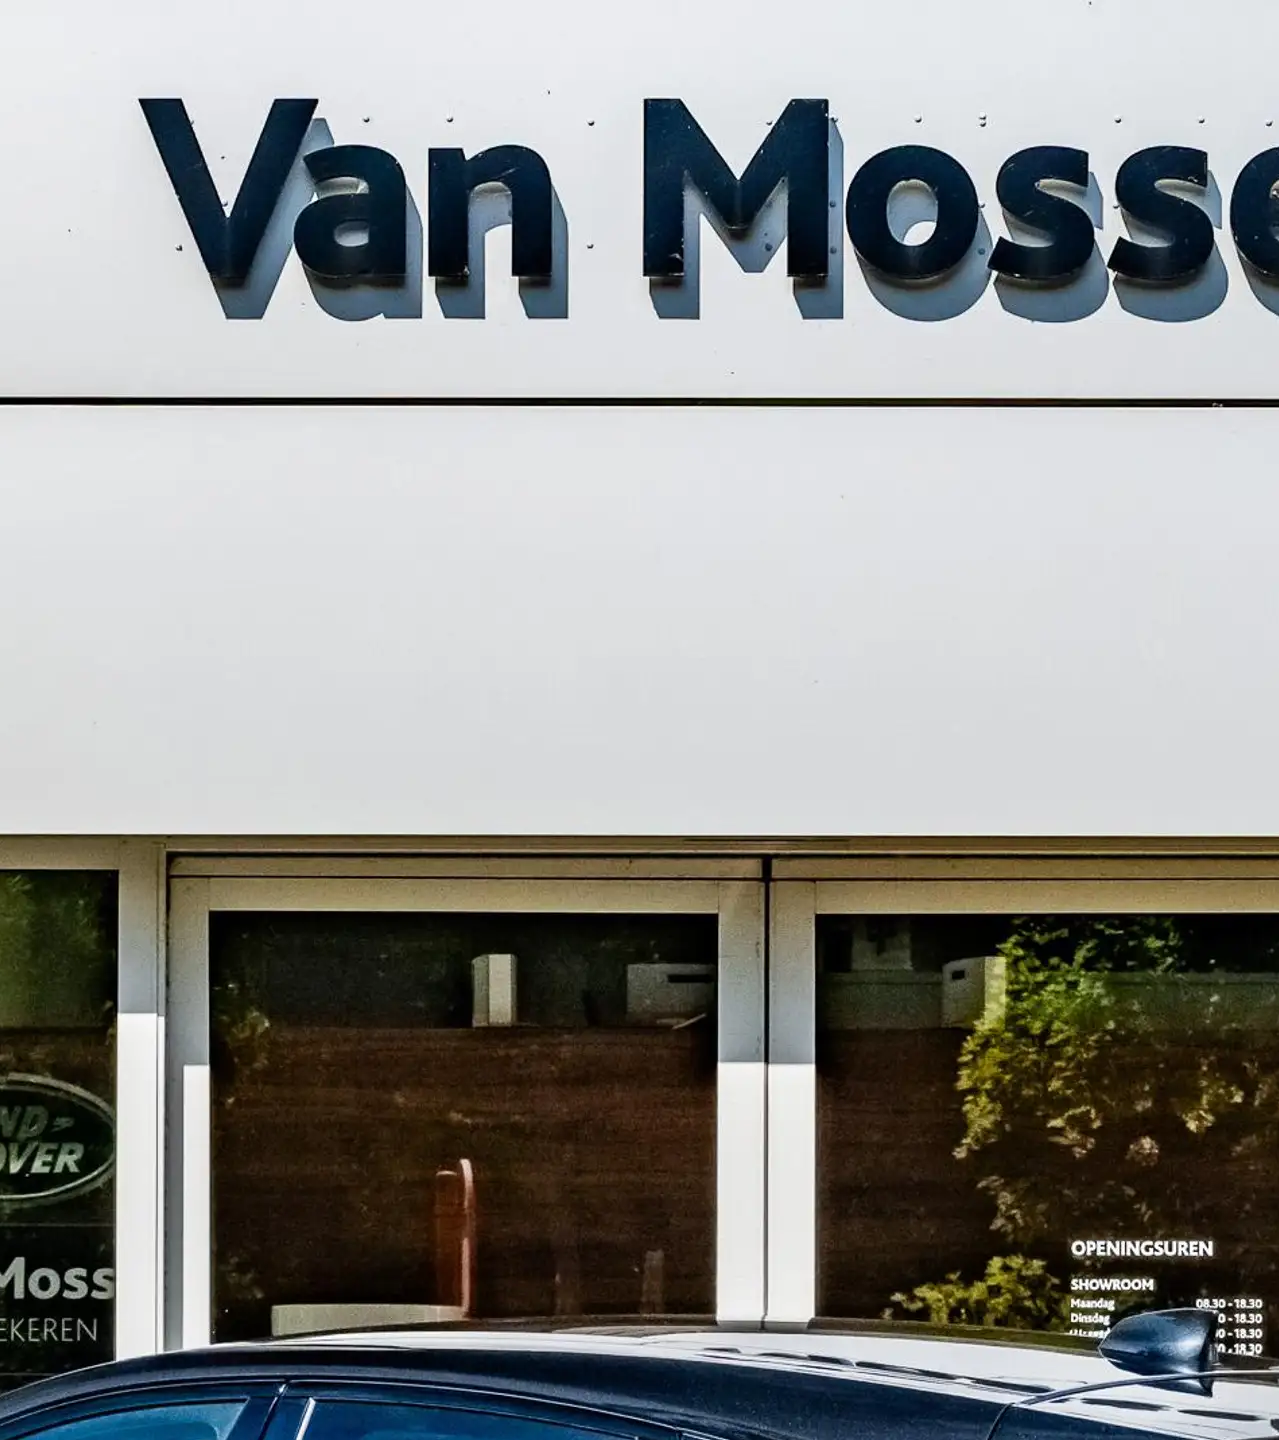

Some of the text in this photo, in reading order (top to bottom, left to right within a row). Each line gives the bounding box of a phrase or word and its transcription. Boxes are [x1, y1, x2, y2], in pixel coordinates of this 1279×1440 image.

[139, 98, 553, 278] Van
[1071, 1240, 1214, 1257] OPENINGSUREN
[1070, 1278, 1154, 1292] SHOWROOM
[1070, 1298, 1115, 1311] Maandag
[1196, 1298, 1226, 1309] 08.30
[1233, 1298, 1263, 1309] 18.30
[1070, 1313, 1110, 1326] Dinsdag
[1233, 1313, 1263, 1324] 18.30
[1233, 1328, 1263, 1339] 18.30
[1233, 1343, 1263, 1355] 18.30
